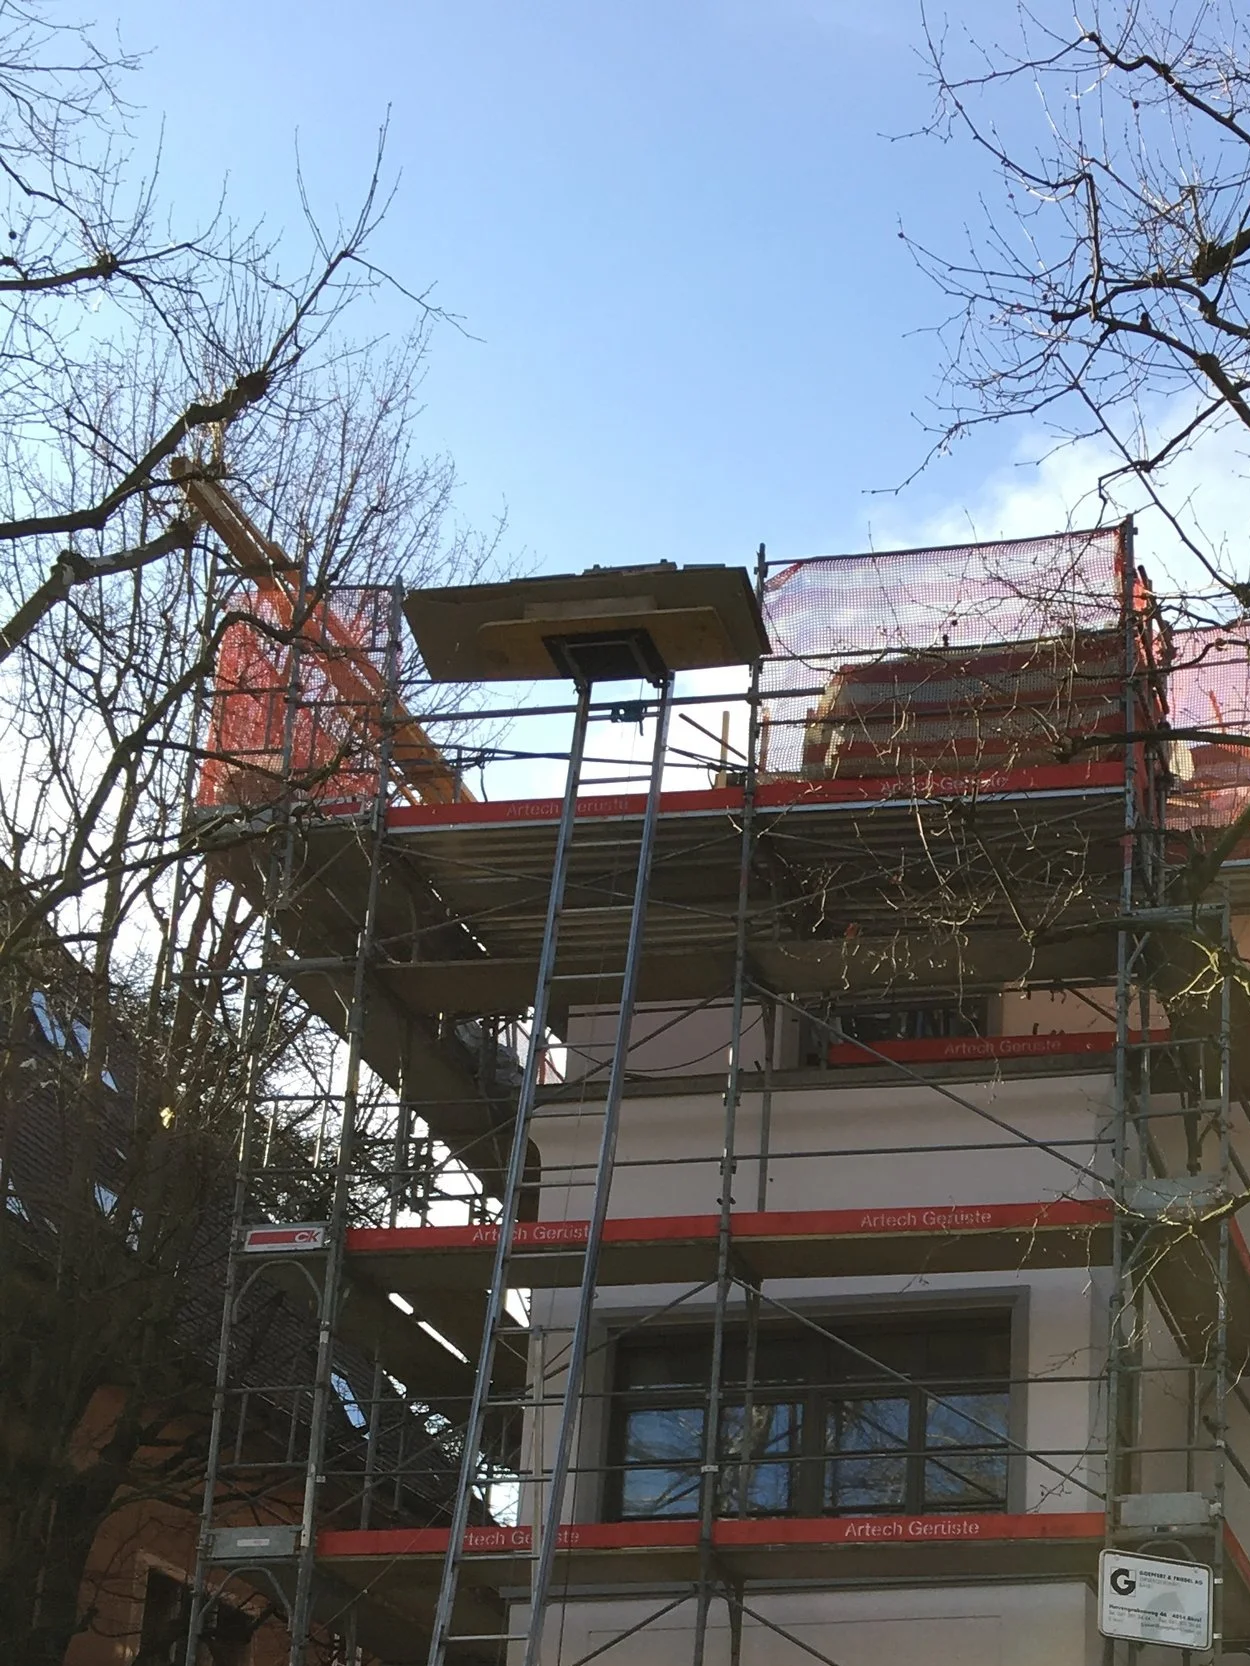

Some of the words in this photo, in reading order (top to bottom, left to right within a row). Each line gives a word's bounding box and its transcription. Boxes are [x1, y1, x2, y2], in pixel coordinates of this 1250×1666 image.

[861, 1212, 917, 1228] Artech
[533, 1224, 591, 1239] Gerüst
[845, 1521, 903, 1537] Artech
[908, 1520, 980, 1536] Gerüste
[1110, 1568, 1136, 1596] G
